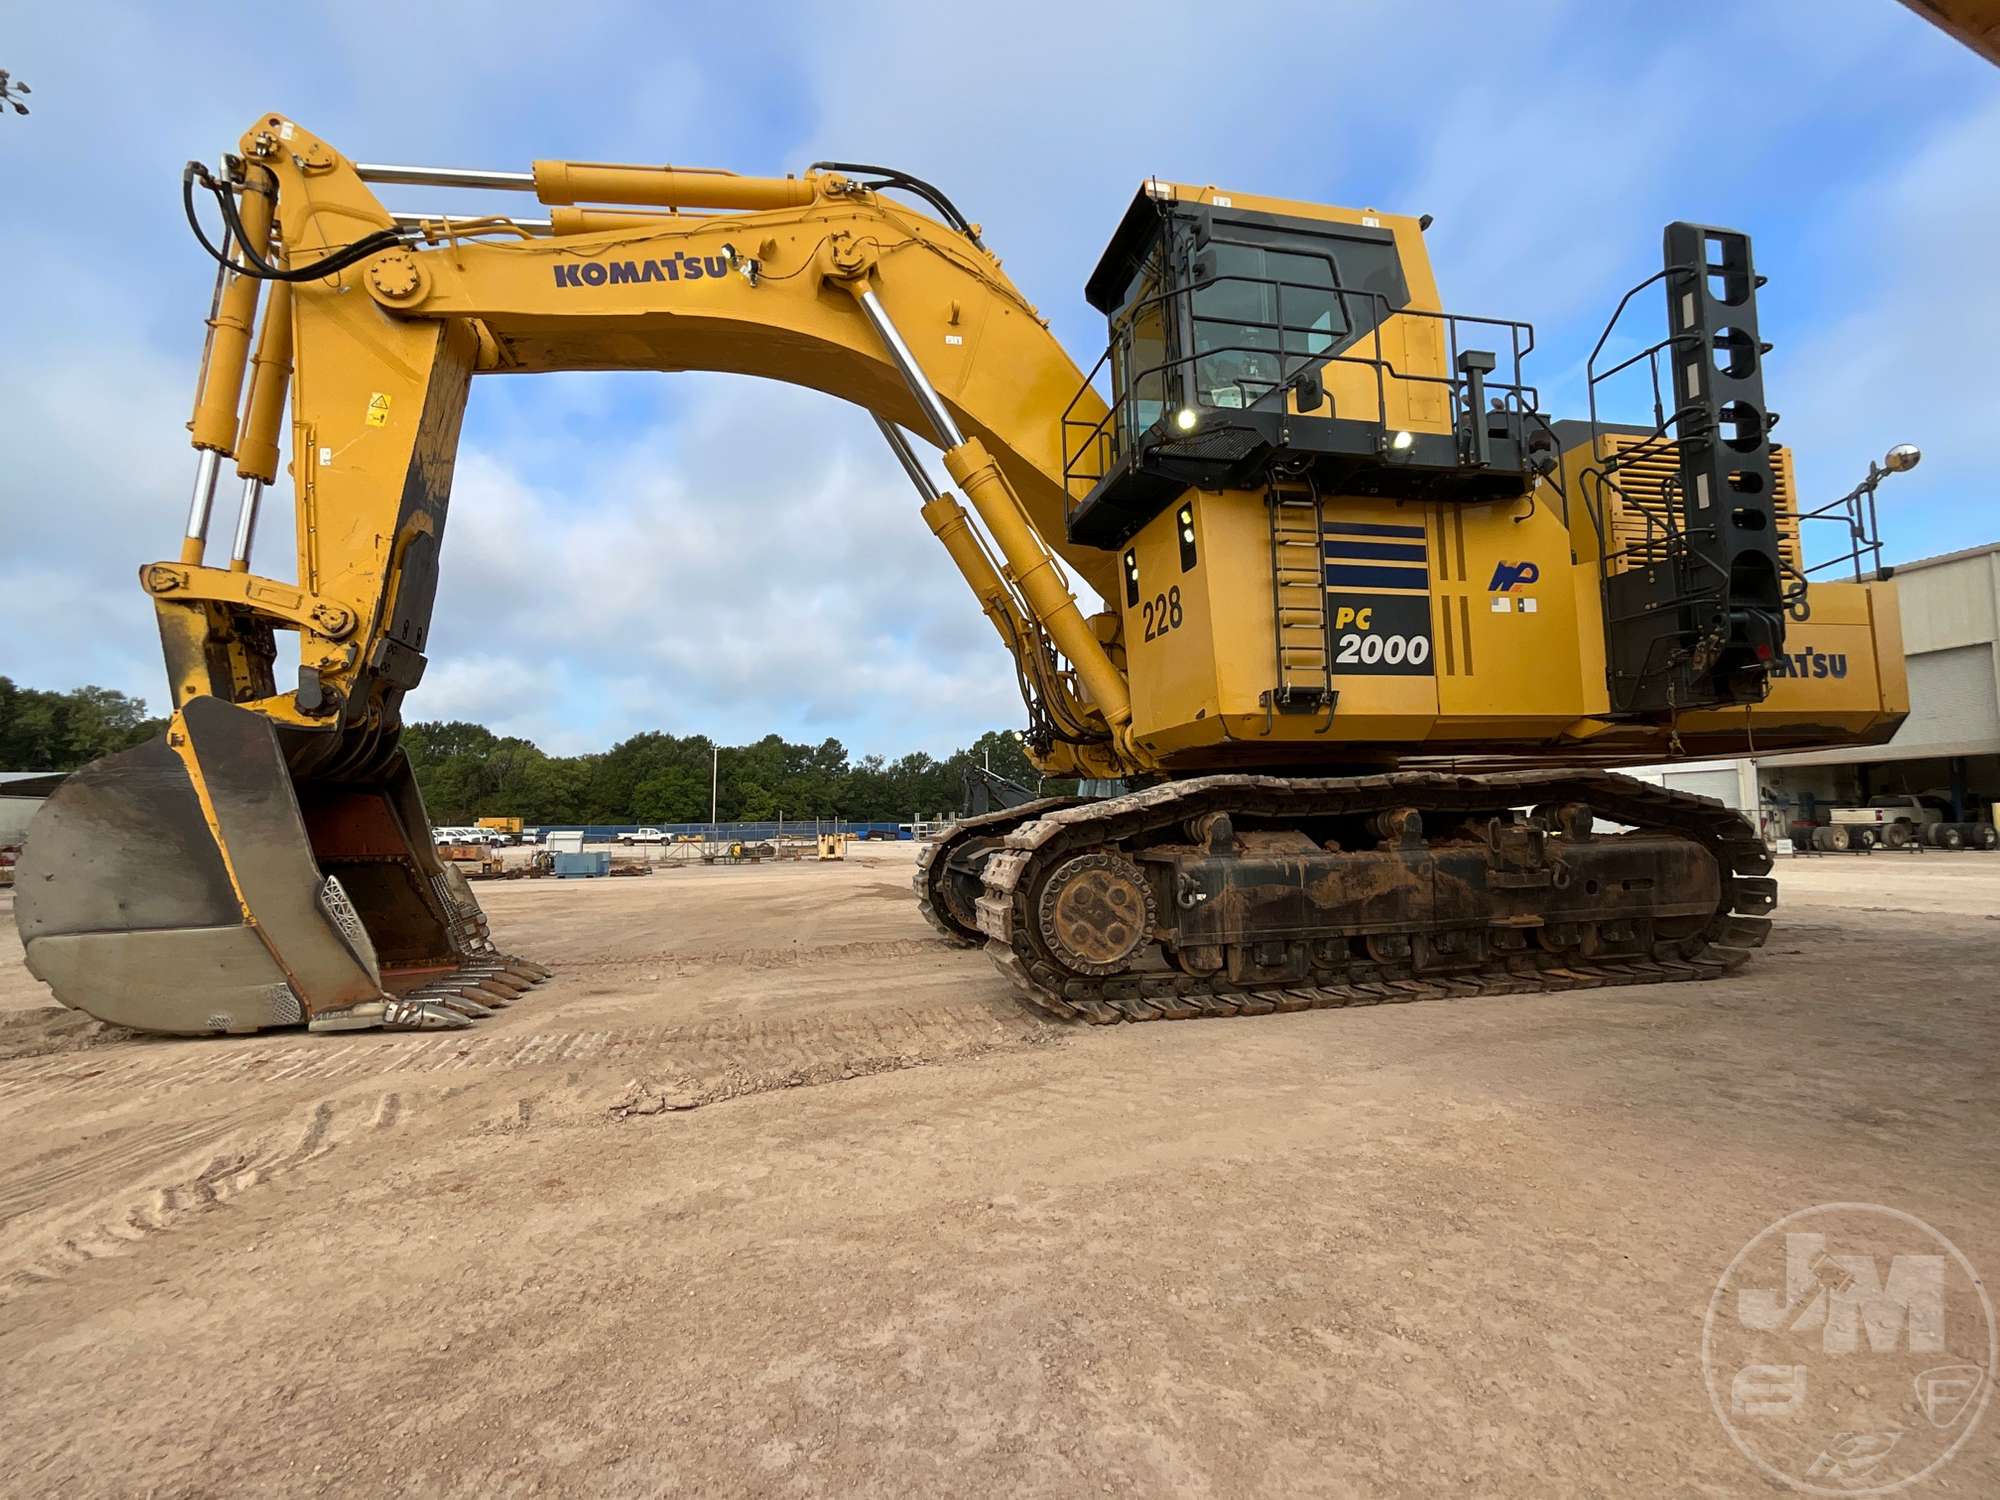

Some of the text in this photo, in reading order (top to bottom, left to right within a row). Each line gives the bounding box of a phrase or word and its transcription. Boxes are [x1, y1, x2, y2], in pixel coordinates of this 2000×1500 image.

[553, 251, 728, 288] KOMATSU
[1142, 584, 1183, 643] 228
[1335, 607, 1372, 630] PC
[1335, 633, 1429, 664] 2000
[1771, 646, 1847, 679] ATSU
